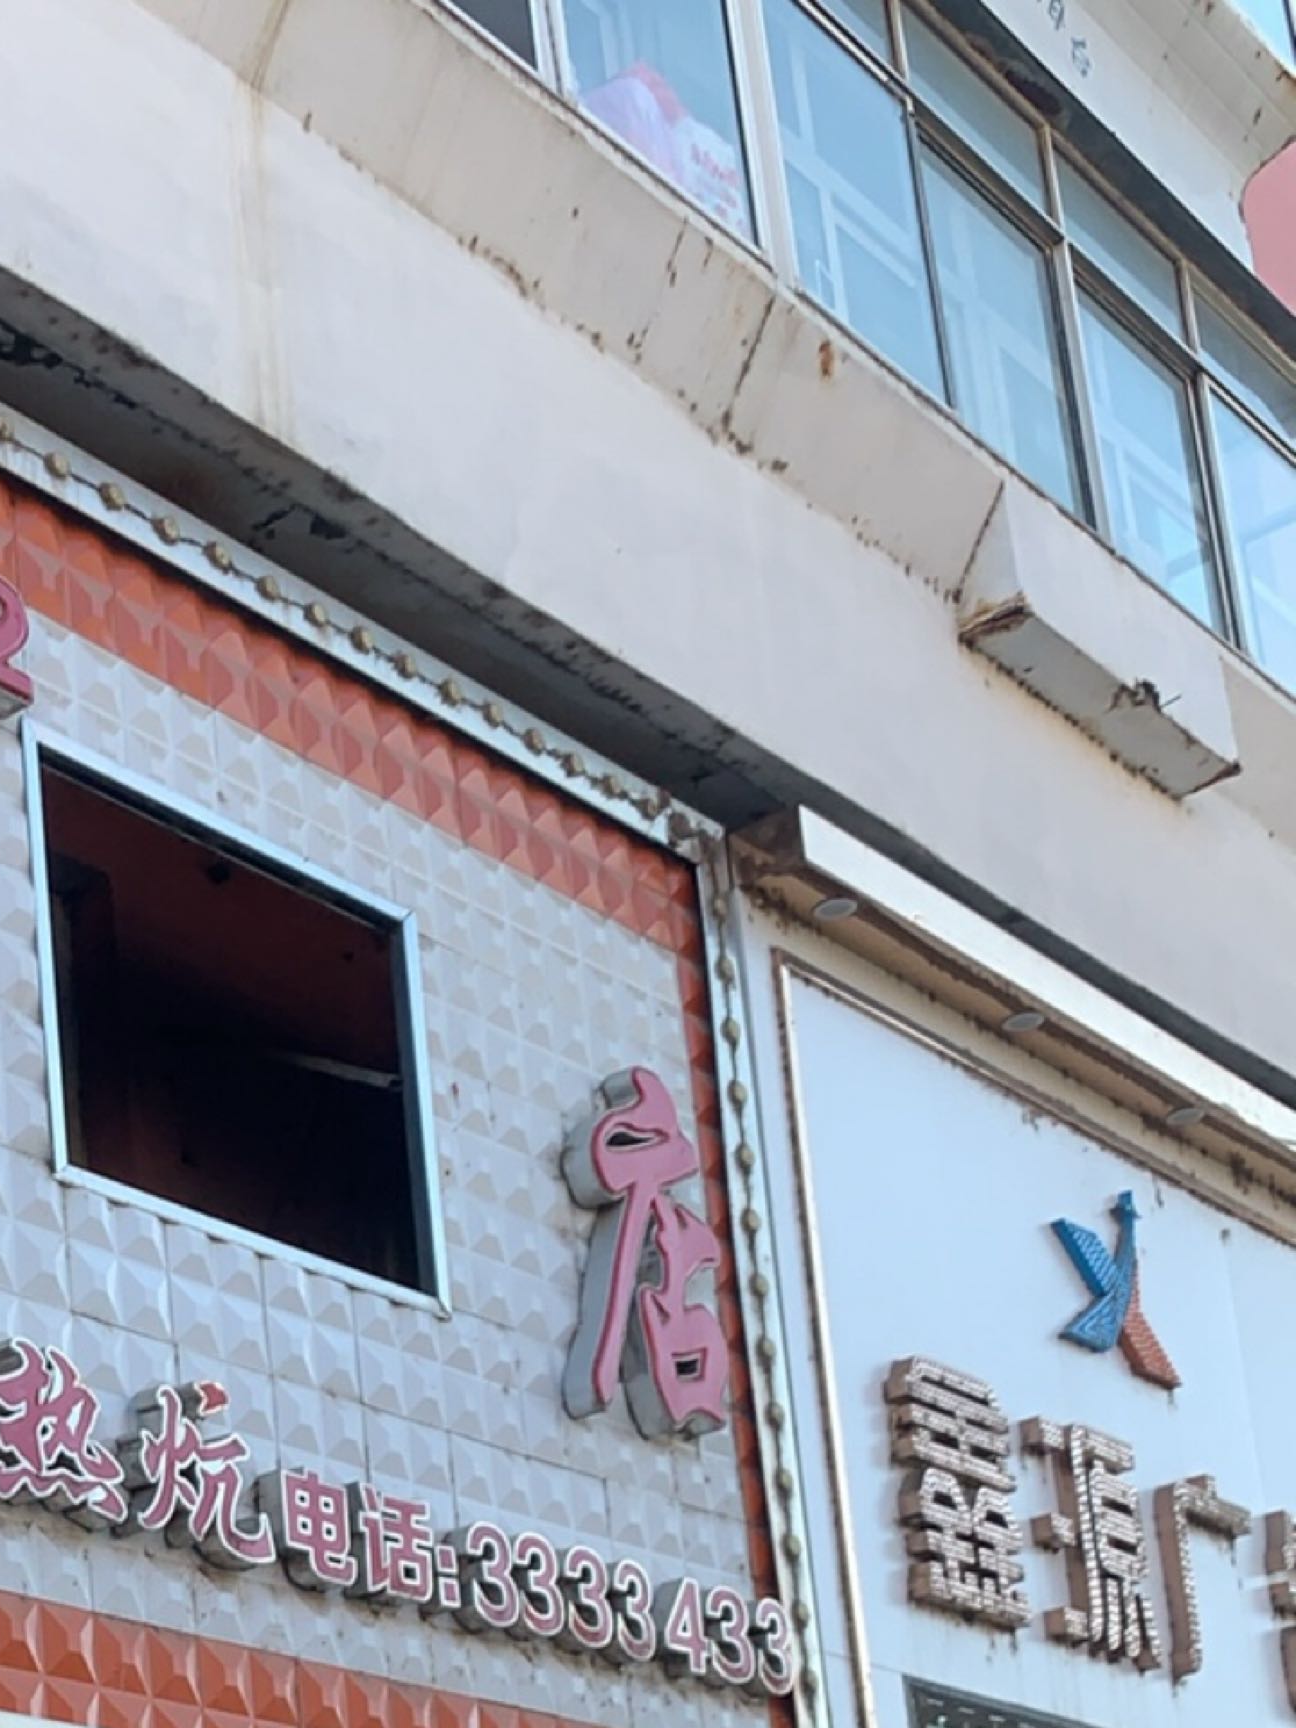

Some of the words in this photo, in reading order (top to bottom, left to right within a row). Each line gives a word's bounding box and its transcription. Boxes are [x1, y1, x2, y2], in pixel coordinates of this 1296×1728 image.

[592, 1065, 728, 1430] 店
[902, 1353, 1296, 1712] 鑫源广
